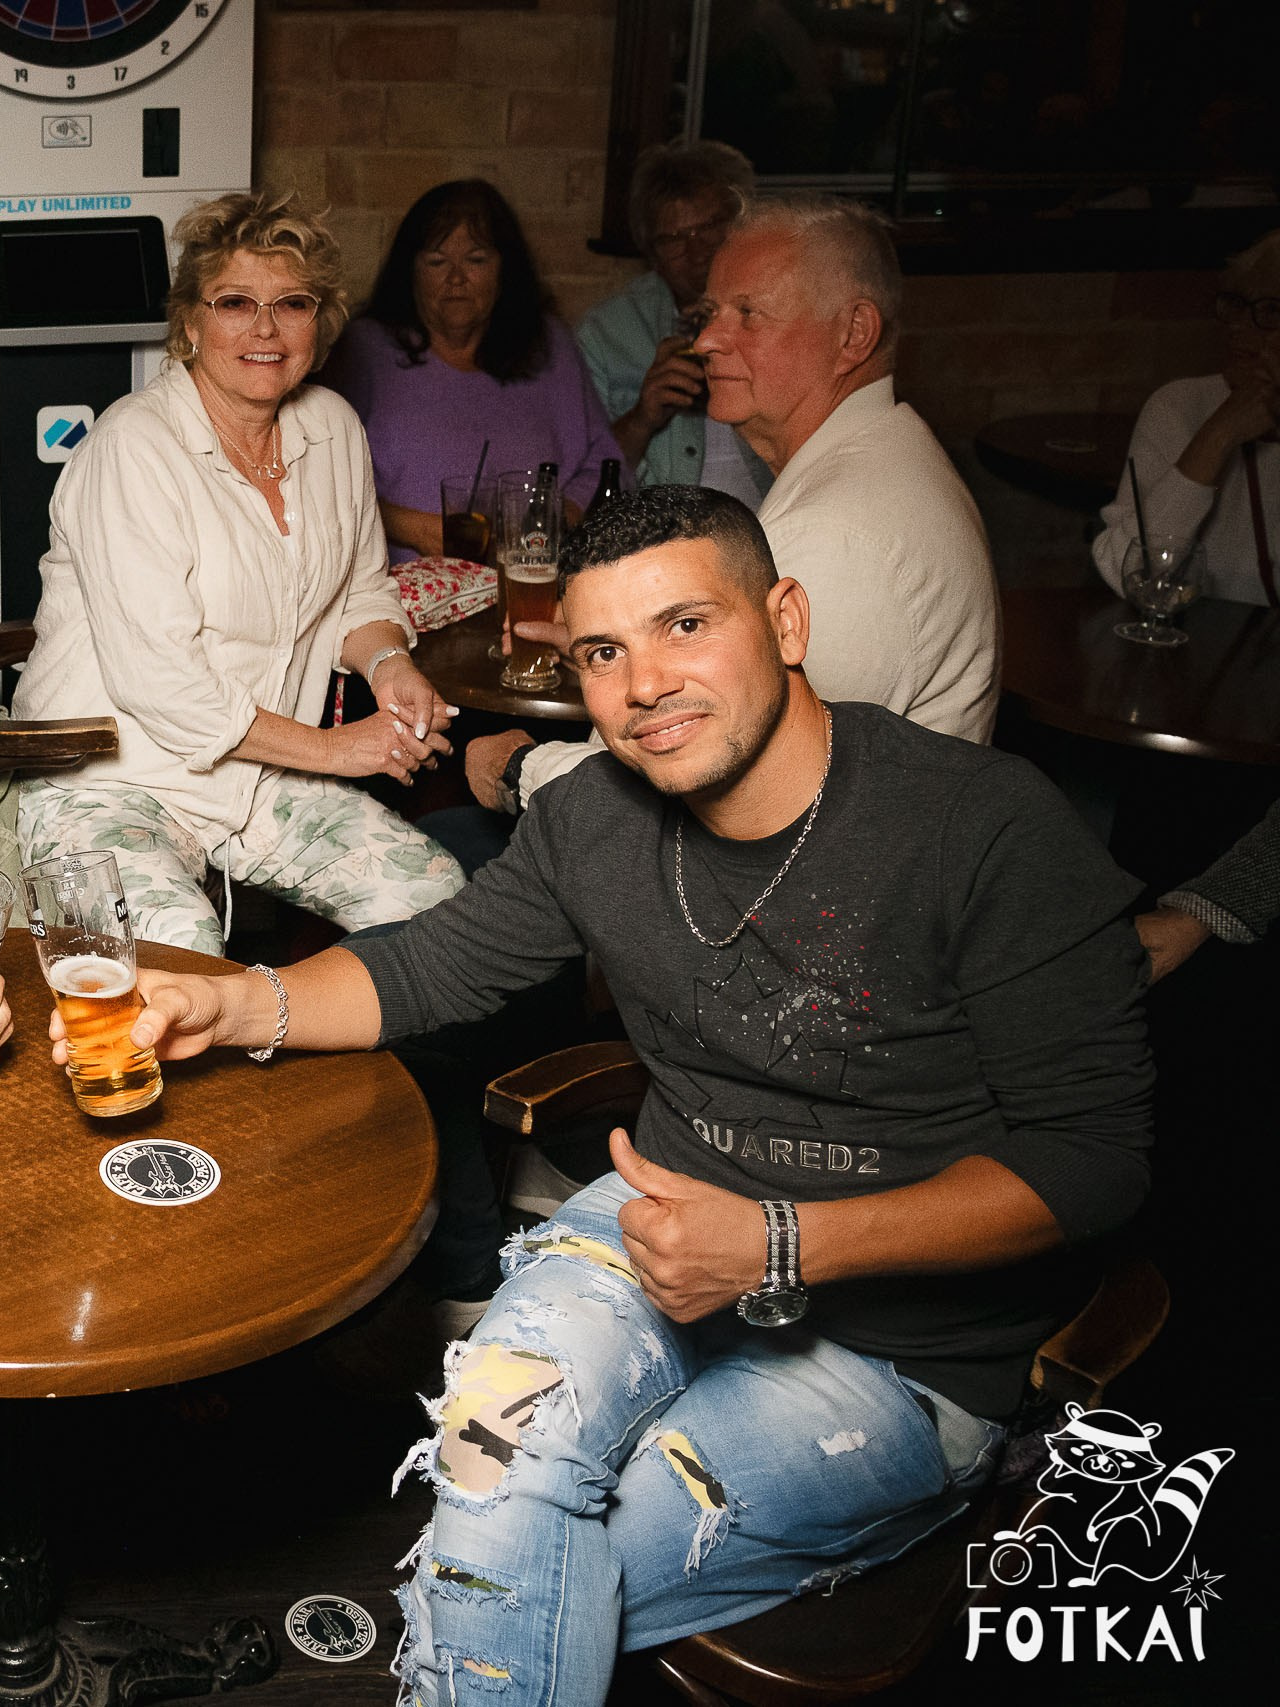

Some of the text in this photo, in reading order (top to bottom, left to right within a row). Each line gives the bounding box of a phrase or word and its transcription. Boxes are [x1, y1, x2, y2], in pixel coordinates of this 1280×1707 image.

[195, 4, 209, 18] 15
[161, 40, 170, 56] 2
[14, 68, 29, 83] 19
[113, 66, 128, 82] 17
[66, 75, 76, 90] 3
[41, 196, 132, 212] UNLIMITED
[692, 1117, 880, 1174] QUARED2
[113, 1146, 144, 1164] BAR
[293, 1606, 312, 1626] BAR
